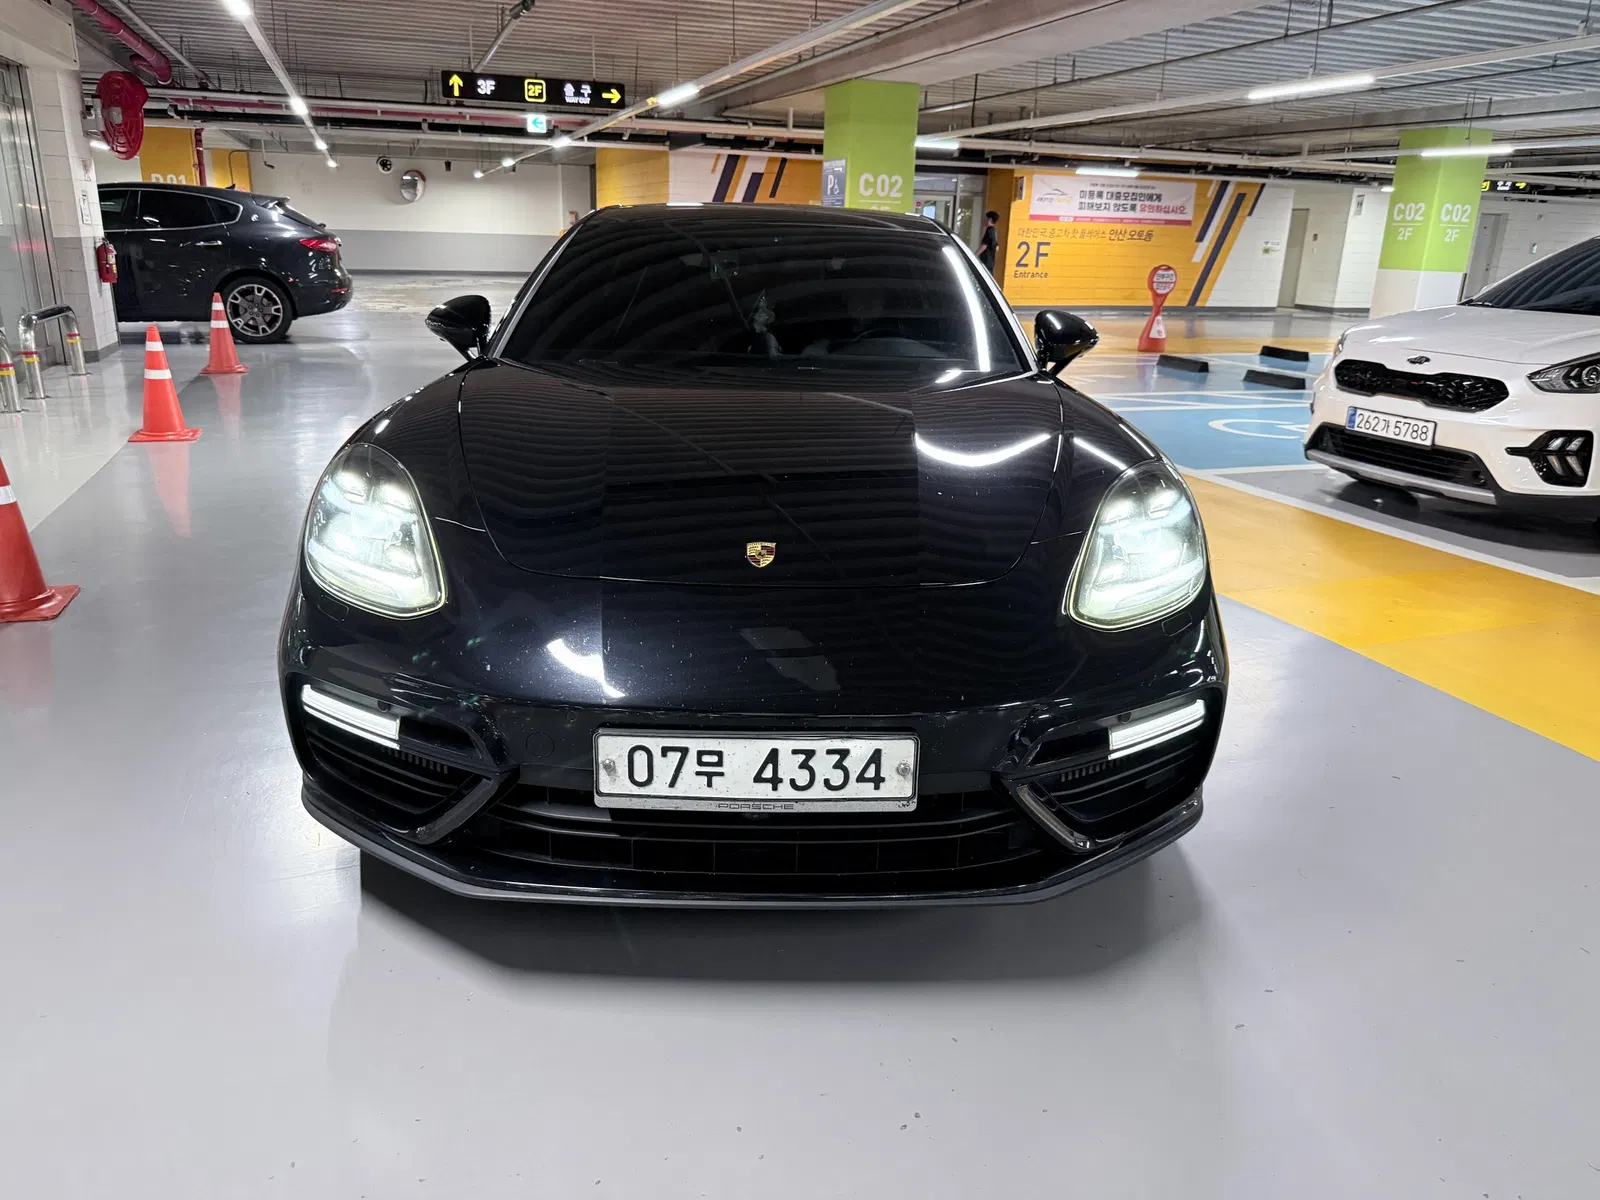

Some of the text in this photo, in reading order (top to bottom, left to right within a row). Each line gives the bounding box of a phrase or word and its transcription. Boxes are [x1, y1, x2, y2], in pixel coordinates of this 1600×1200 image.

[477, 79, 496, 95] 3F
[527, 85, 543, 97] 2F
[859, 172, 903, 198] C02
[1113, 203, 1137, 213] 않도록
[1393, 202, 1425, 221] C02
[1440, 203, 1472, 223] C02
[1017, 228, 1046, 239] 대한민국
[1048, 228, 1070, 239] 중고차
[1080, 229, 1106, 239] 플레이스
[1108, 229, 1127, 242] 안산
[1397, 227, 1413, 241] 2F
[1444, 228, 1460, 243] 2F
[1015, 241, 1051, 268] 2F
[1013, 270, 1049, 279] Entrance
[1356, 412, 1390, 434] 262가
[1392, 421, 1429, 442] 5788
[627, 744, 886, 792] 07무 4334
